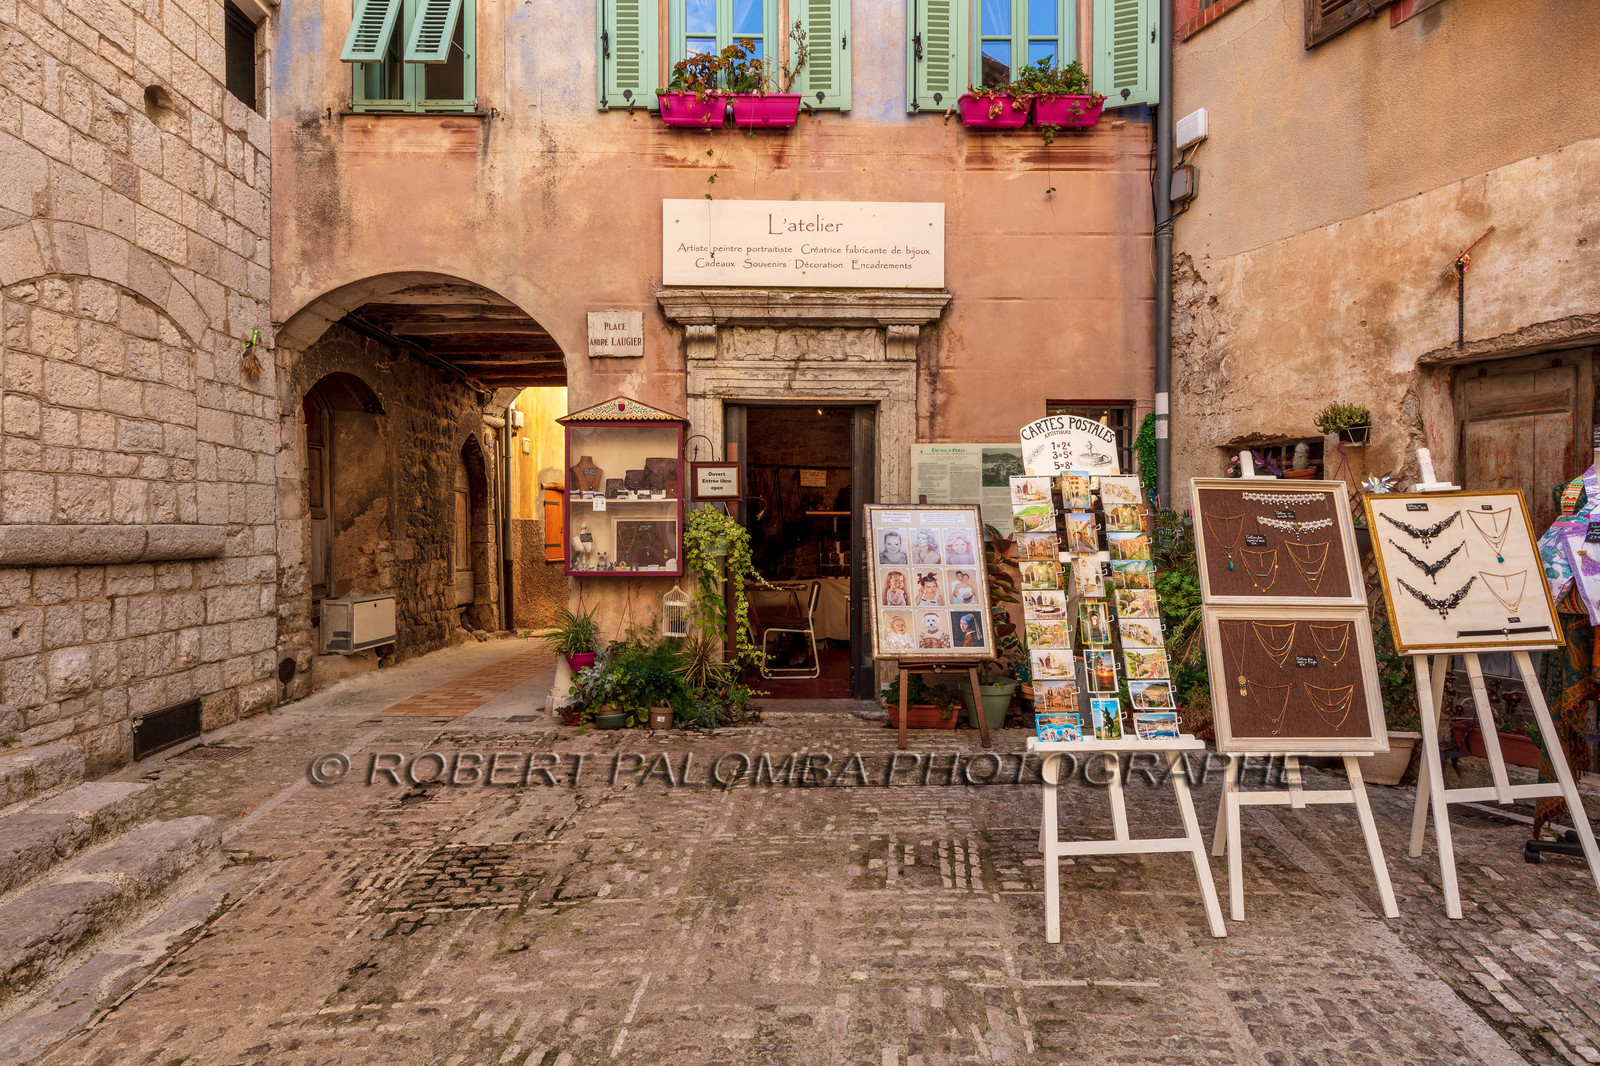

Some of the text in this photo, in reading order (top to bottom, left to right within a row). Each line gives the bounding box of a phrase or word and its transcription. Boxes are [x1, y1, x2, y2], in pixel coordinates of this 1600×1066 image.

[768, 213, 844, 235] L'atelier
[677, 242, 930, 260] Artiste peintre portraitiste Créatrice fabricante de bijoux
[695, 257, 912, 270] Cadeaux Souvenirs Décoration Encadrements
[604, 322, 627, 331] PLACE
[611, 336, 642, 346] LAUGIER
[1021, 416, 1116, 444] CARTES POSTALES
